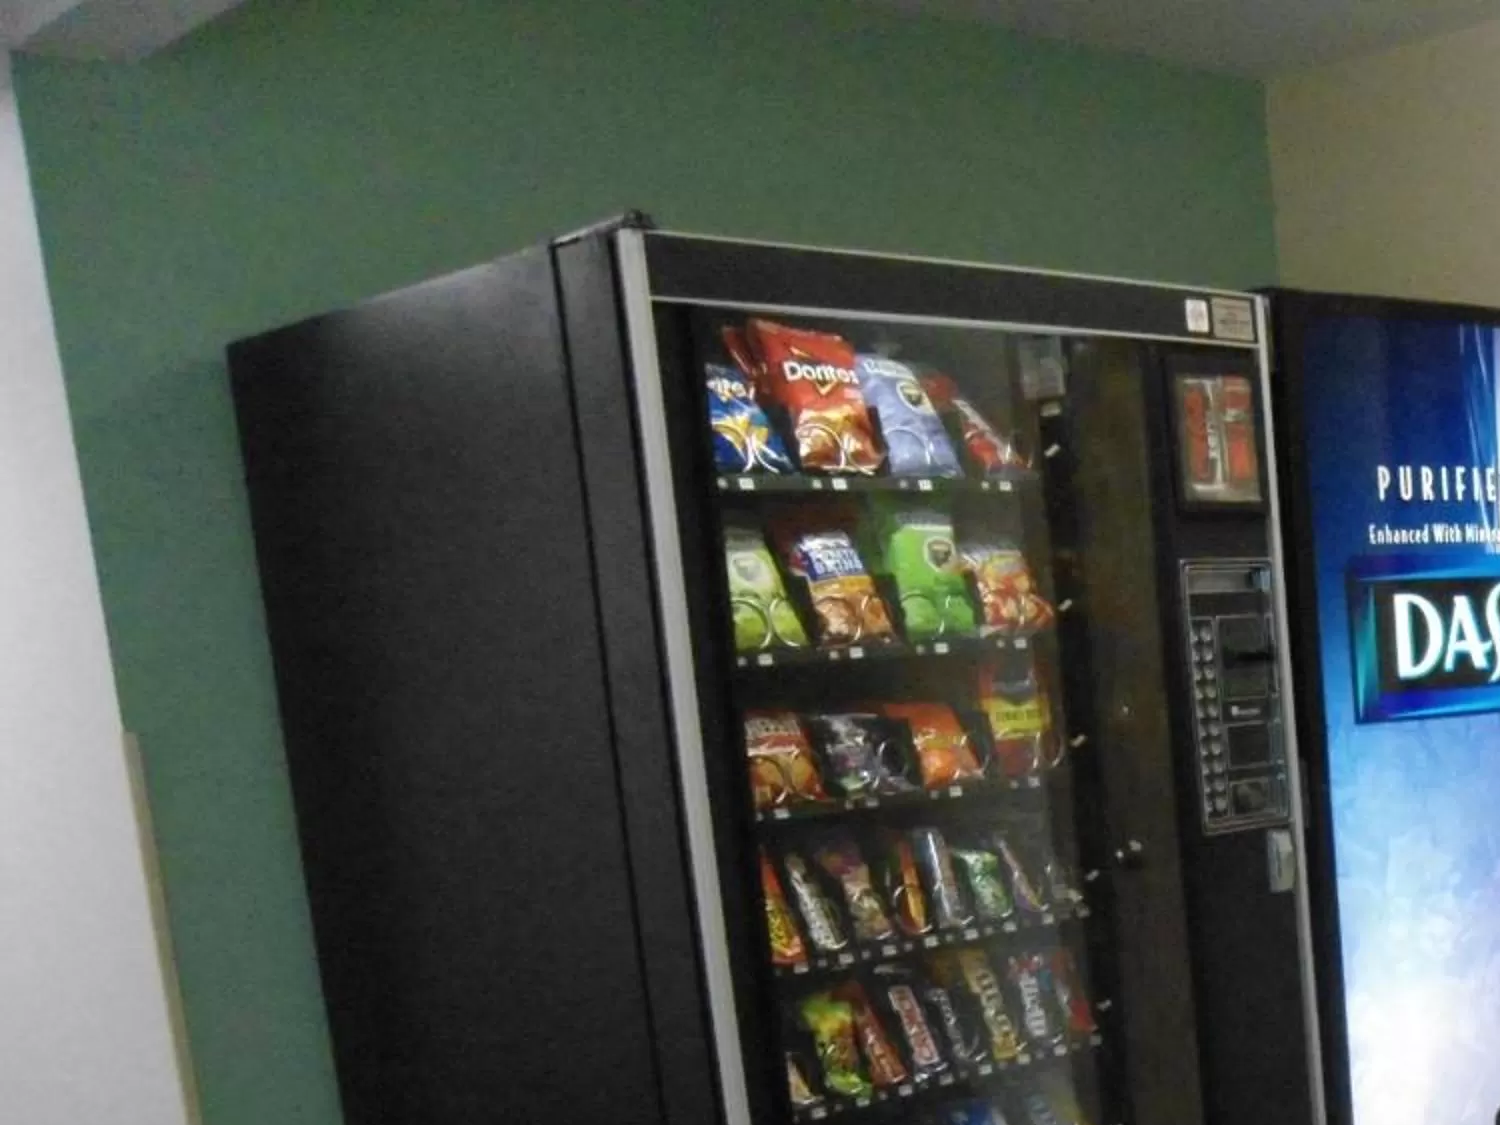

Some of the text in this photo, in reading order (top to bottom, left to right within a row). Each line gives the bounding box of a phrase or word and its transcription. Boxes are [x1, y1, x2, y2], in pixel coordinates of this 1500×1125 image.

[783, 360, 859, 385] Doritos
[1368, 522, 1429, 545] Enhanced
[1432, 522, 1461, 544] With
